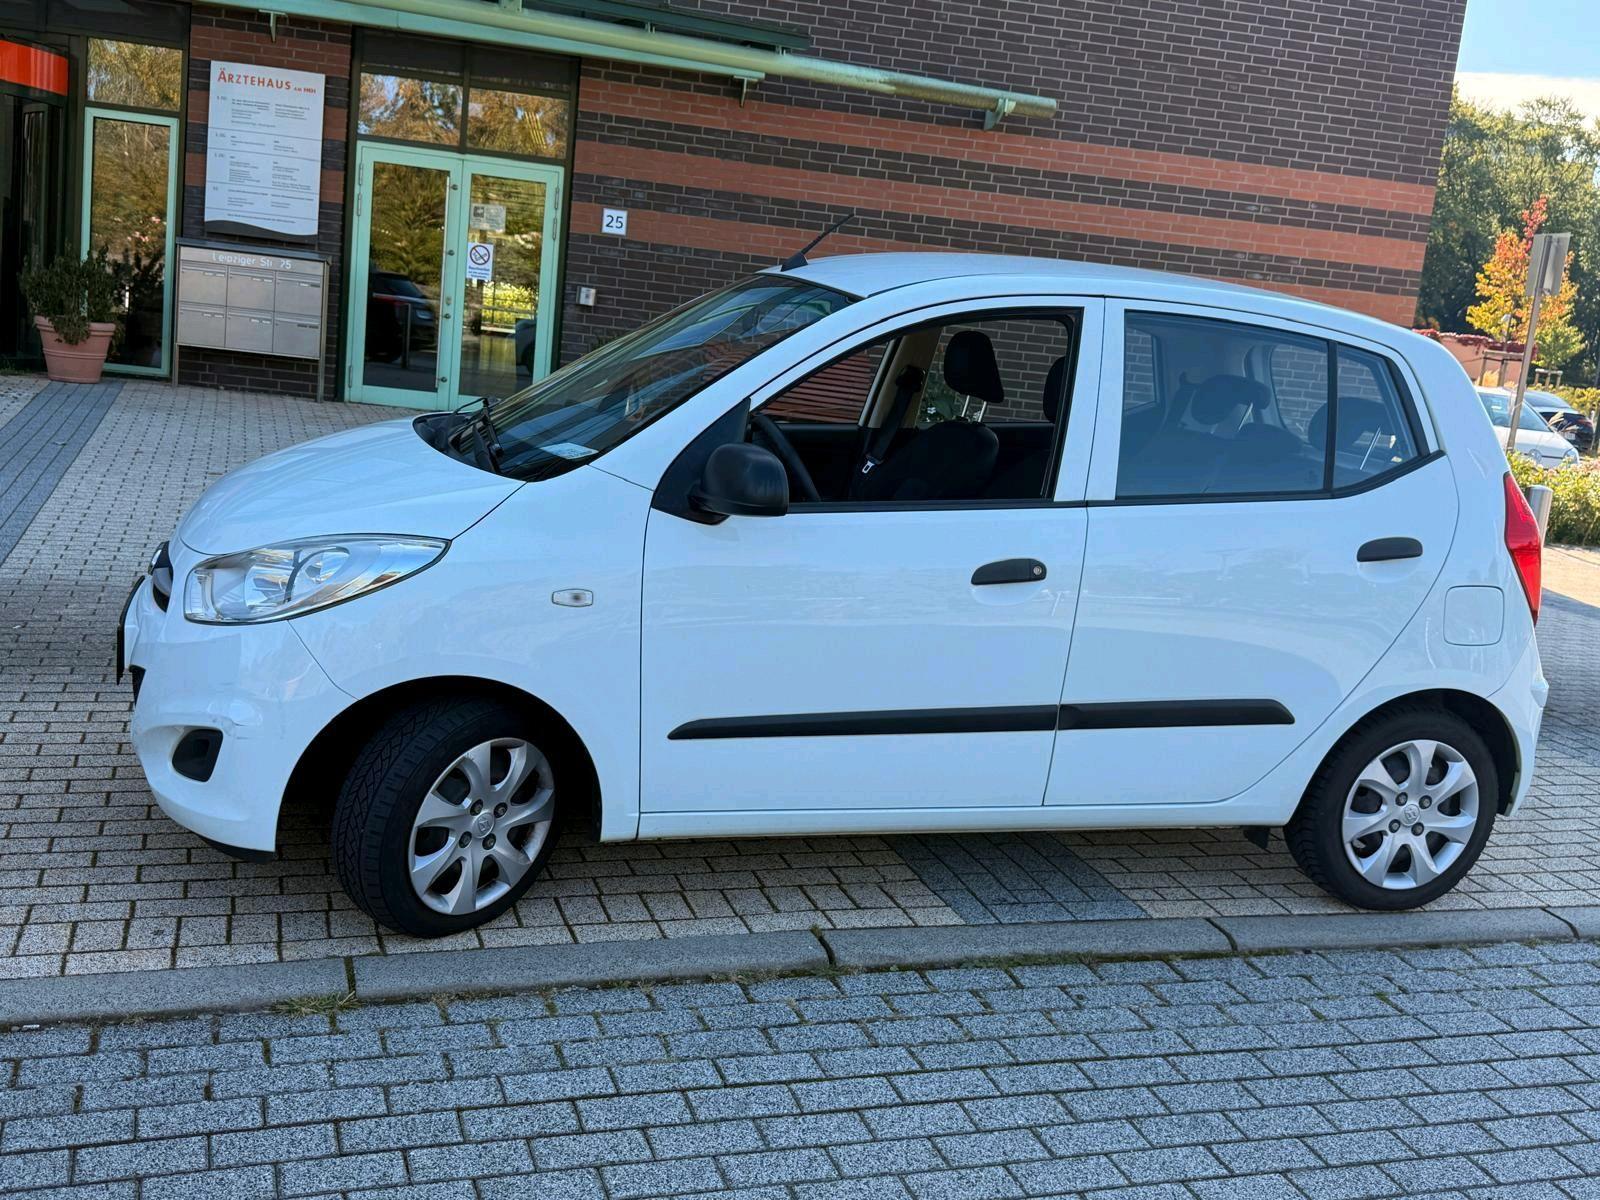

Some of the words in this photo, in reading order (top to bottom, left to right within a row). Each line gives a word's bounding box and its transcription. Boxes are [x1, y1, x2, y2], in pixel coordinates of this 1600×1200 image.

[217, 67, 292, 90] ÄRZTEHAUS
[605, 214, 624, 229] 25
[280, 259, 293, 270] 25
